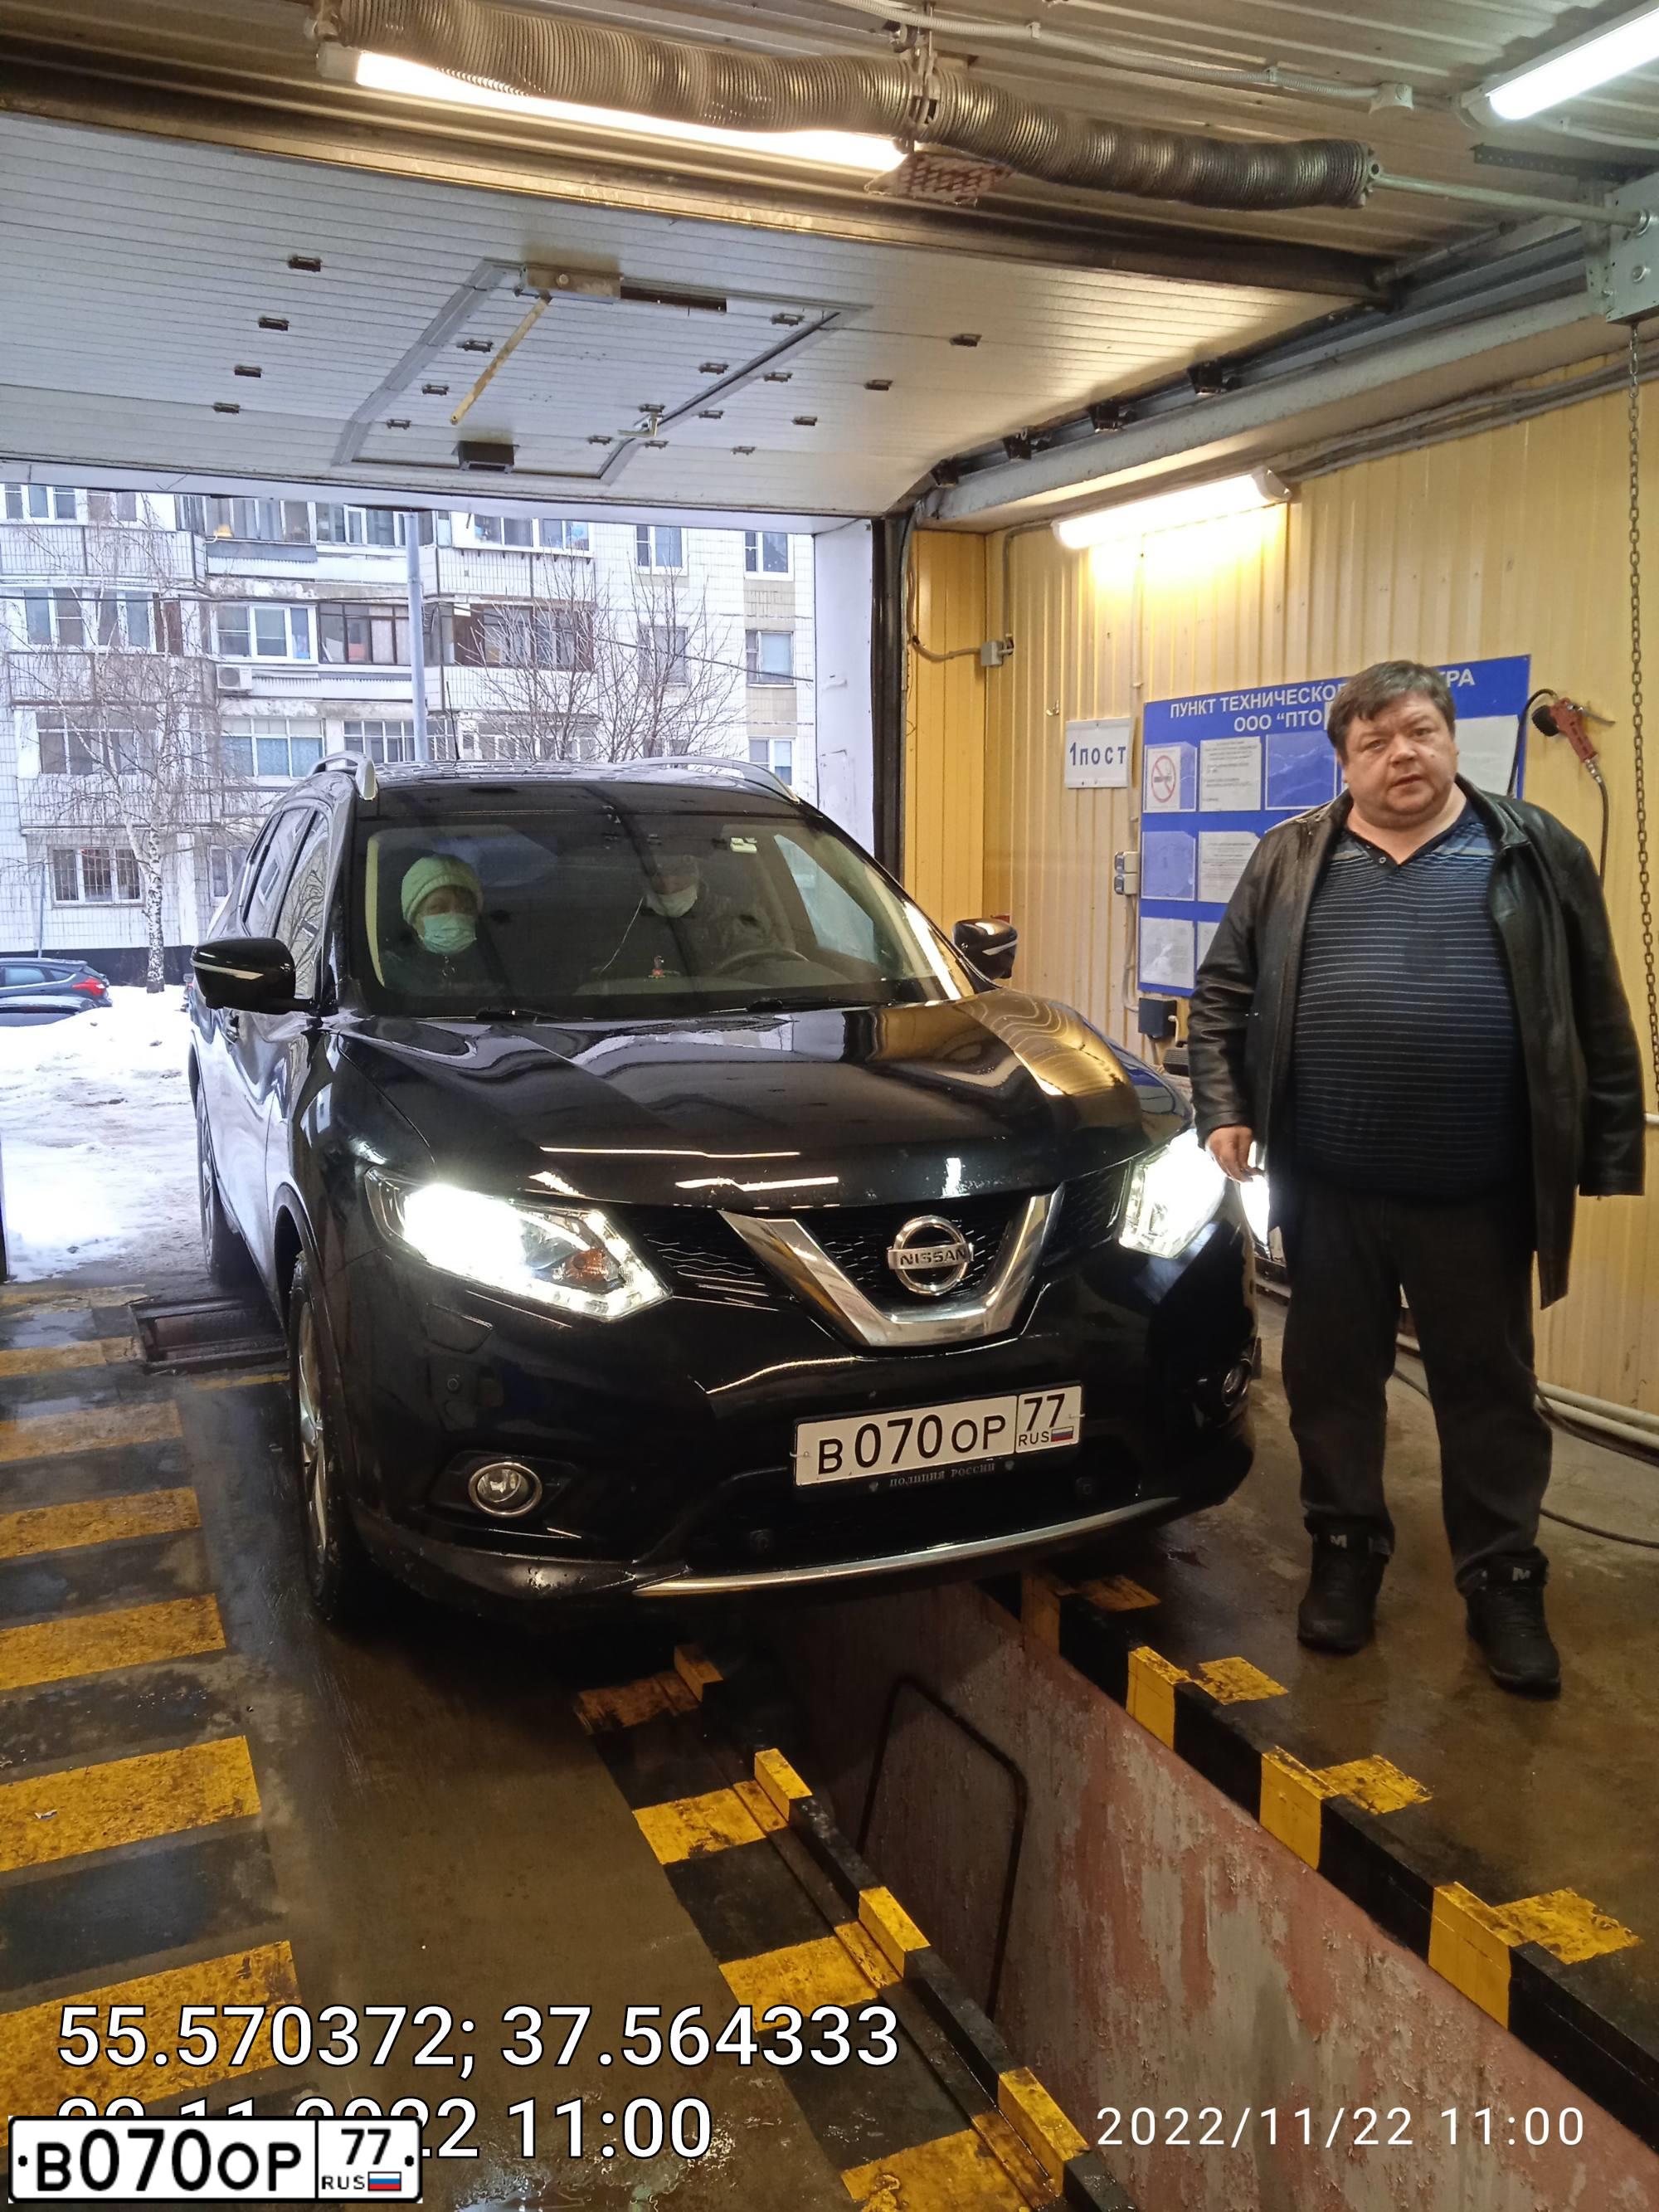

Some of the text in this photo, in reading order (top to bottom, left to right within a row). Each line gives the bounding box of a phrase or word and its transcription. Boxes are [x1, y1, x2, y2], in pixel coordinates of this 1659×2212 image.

[1170, 682, 1347, 719] ПУНКТ ТЕХНИЧЕСКО
[1233, 714, 1272, 733] ООО
[899, 1248, 966, 1266] NISSAN
[1024, 1393, 1066, 1432] 77
[1018, 1430, 1050, 1447] RUS
